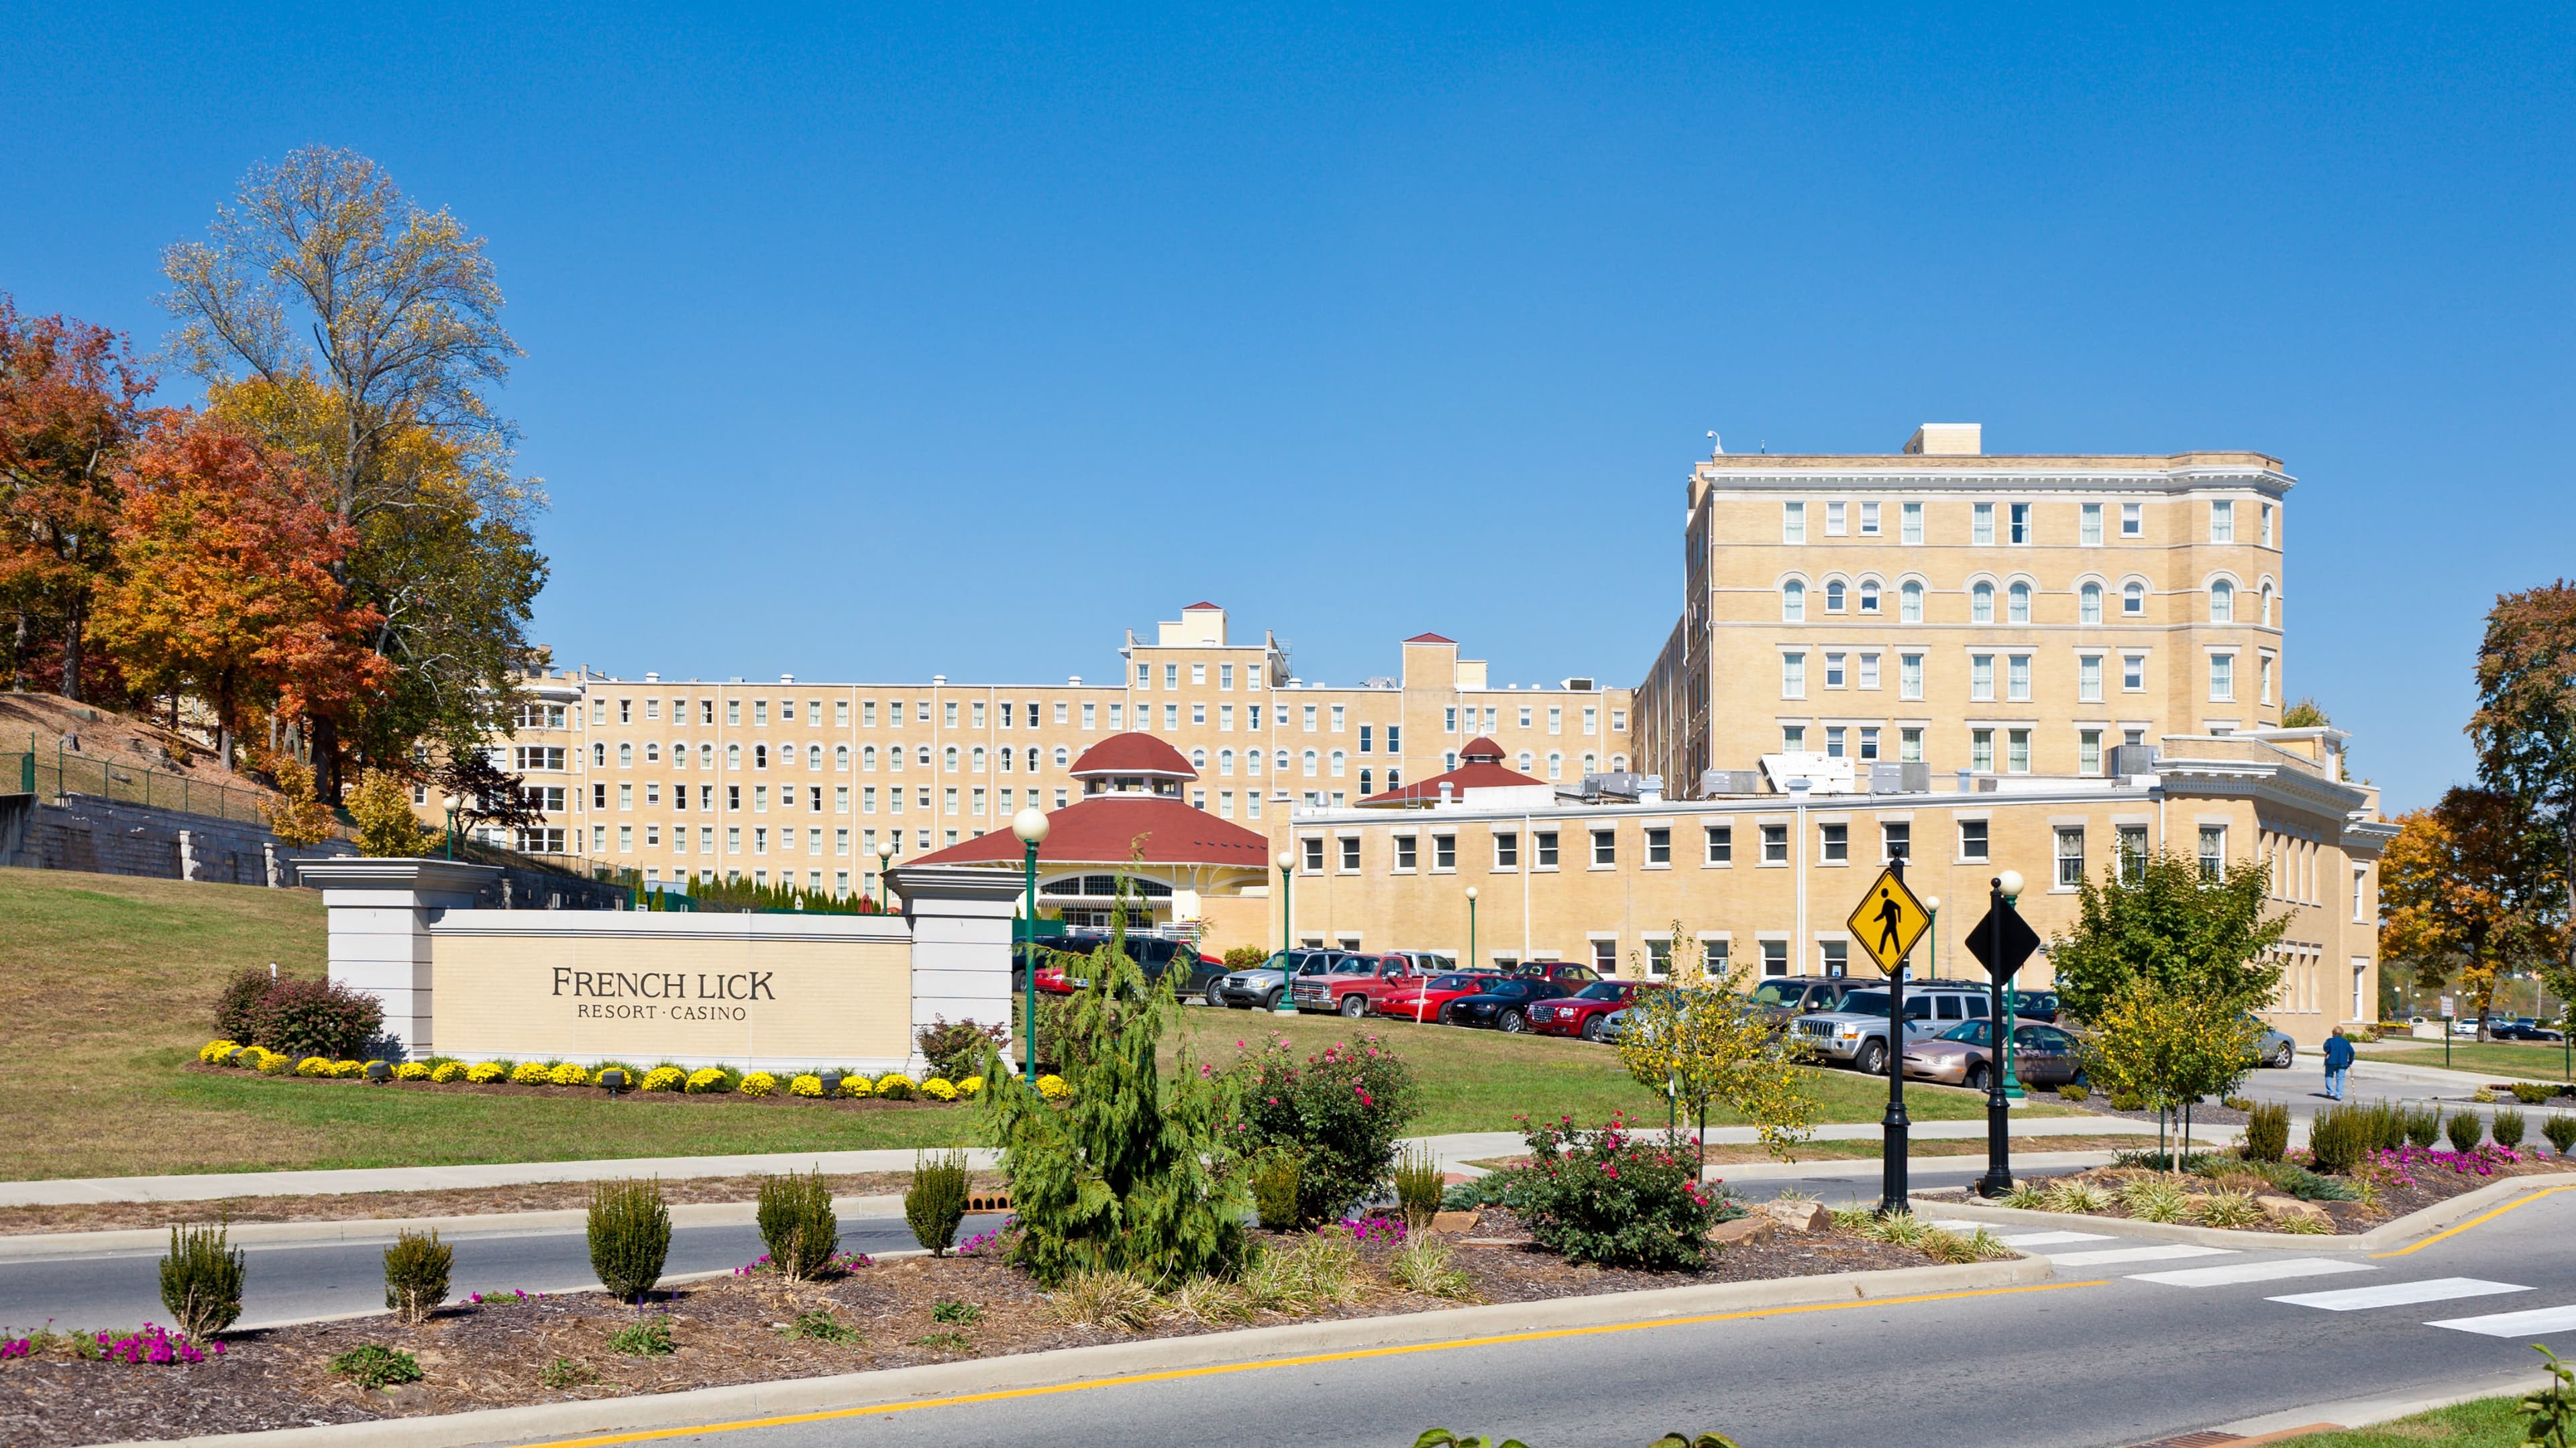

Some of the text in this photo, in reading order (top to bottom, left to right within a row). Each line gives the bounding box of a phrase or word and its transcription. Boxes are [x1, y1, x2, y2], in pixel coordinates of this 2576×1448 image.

[552, 966, 776, 1001] FRENCH LICK
[578, 1004, 746, 1021] RESORT CASINO
